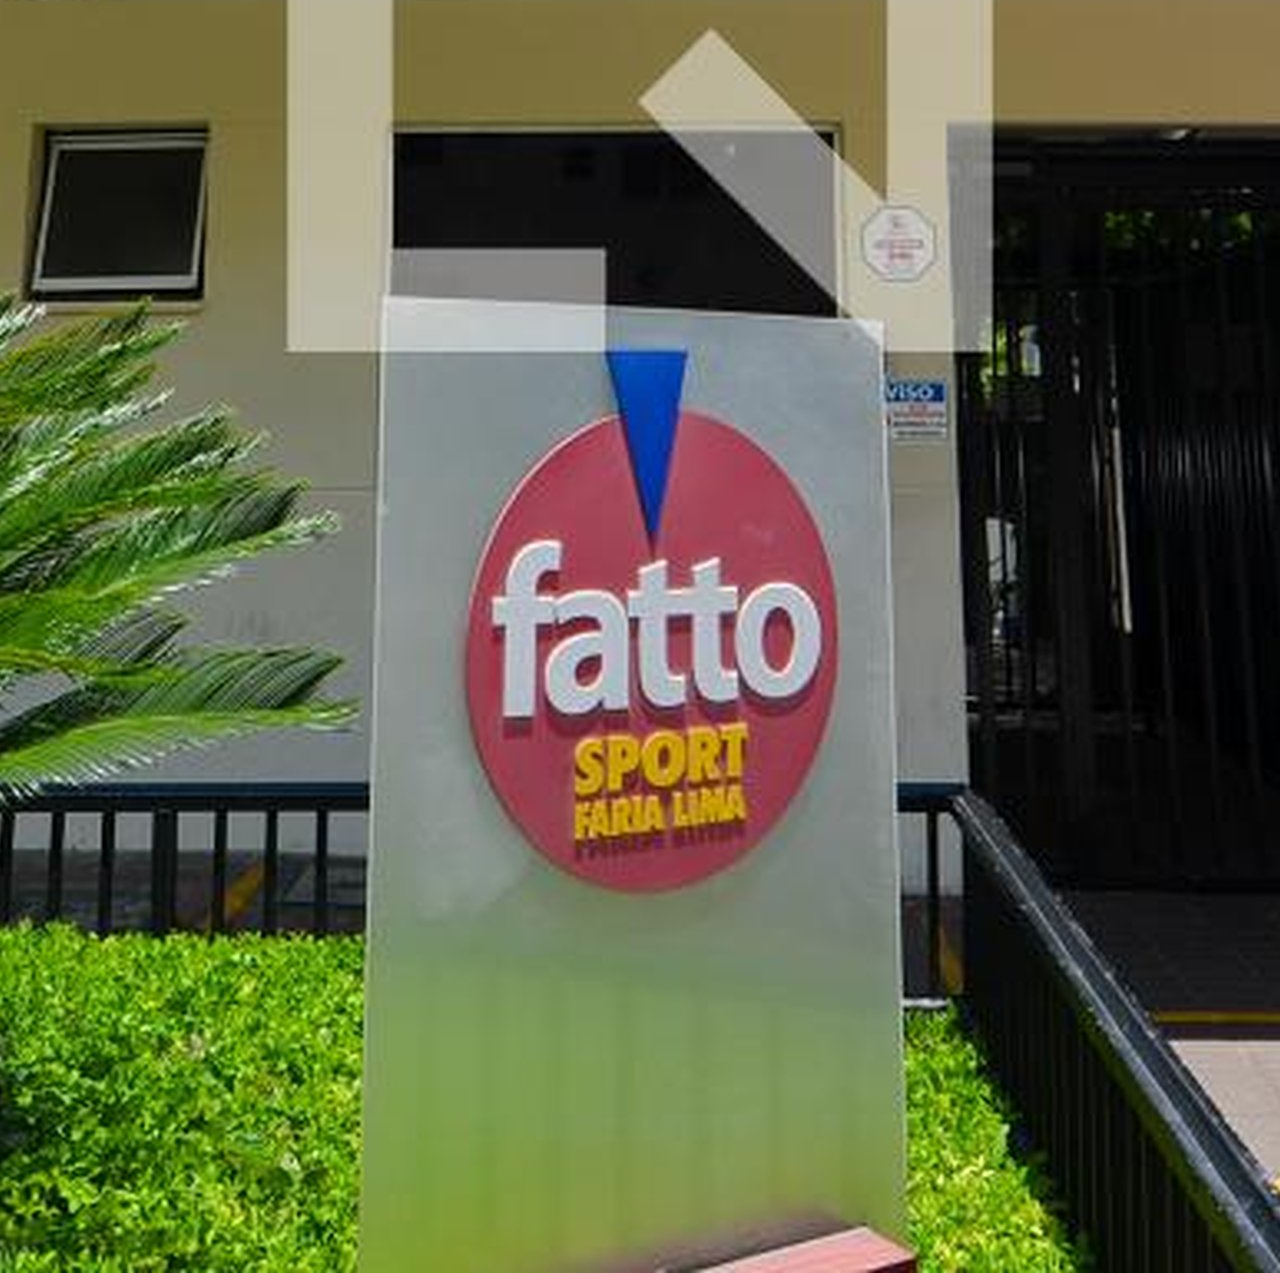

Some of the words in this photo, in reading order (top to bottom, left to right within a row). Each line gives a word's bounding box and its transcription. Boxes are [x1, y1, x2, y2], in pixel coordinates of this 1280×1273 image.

[886, 383, 935, 400] VISO
[491, 539, 823, 719] fatto
[572, 721, 750, 798] SPORT
[573, 794, 666, 842] FARIA
[672, 784, 747, 827] LIMA
